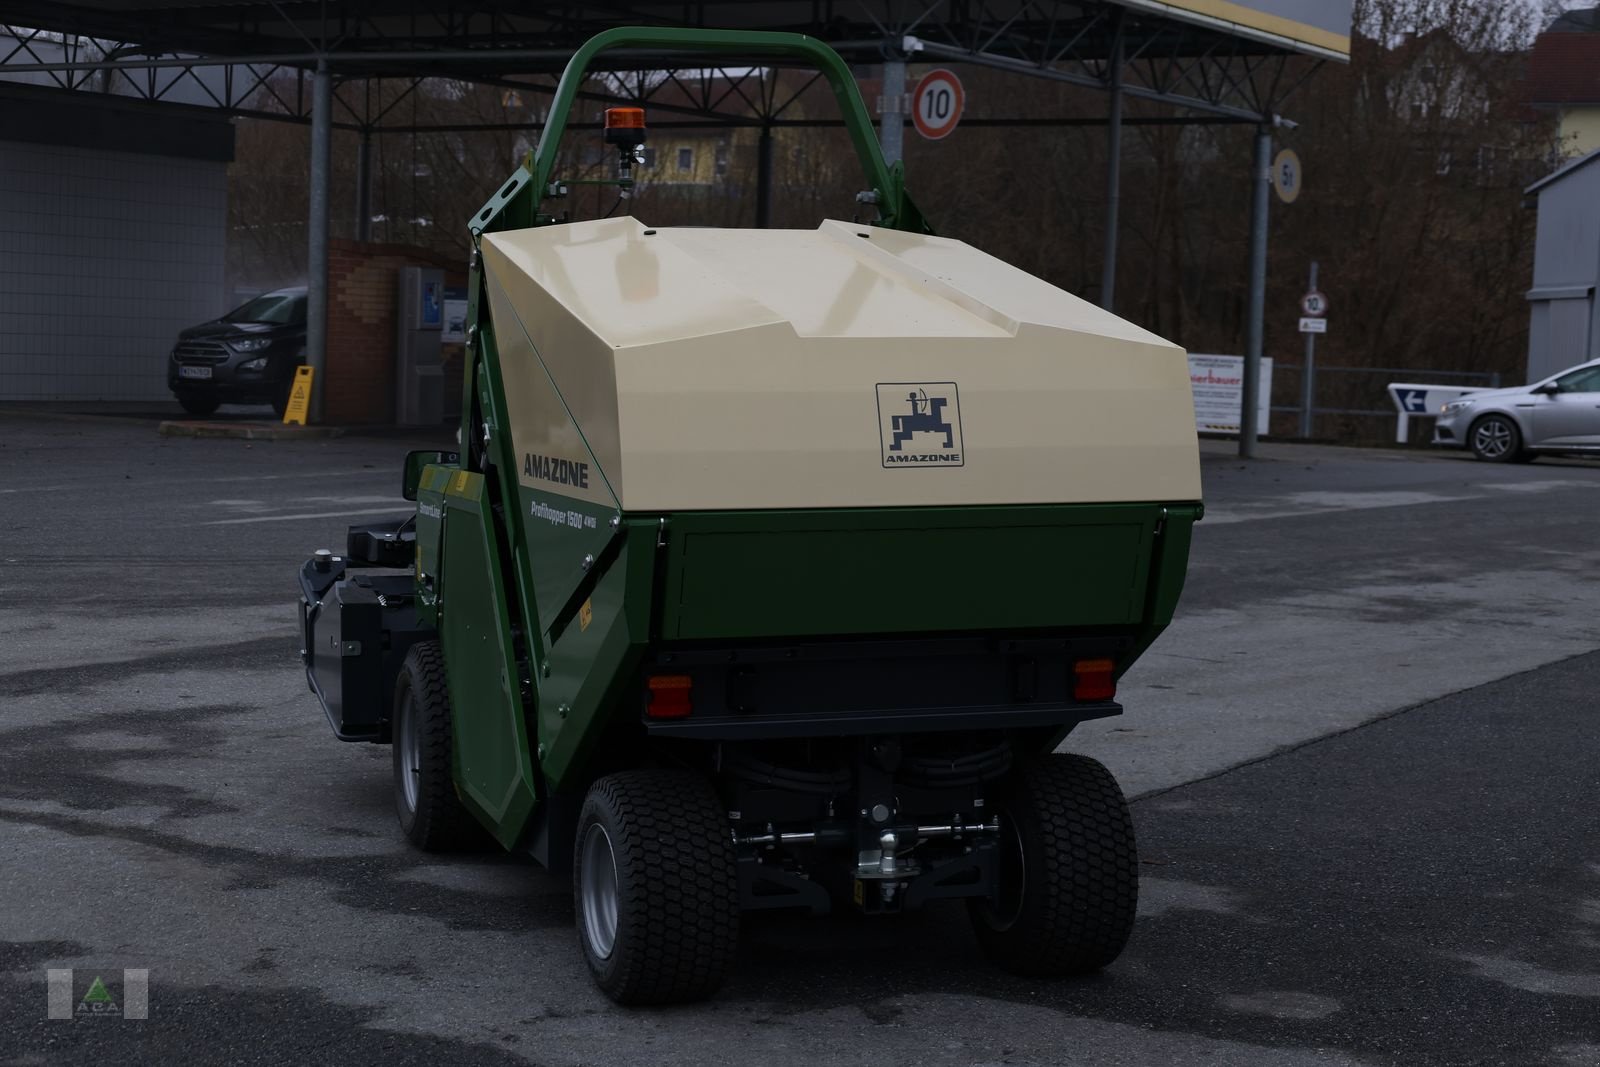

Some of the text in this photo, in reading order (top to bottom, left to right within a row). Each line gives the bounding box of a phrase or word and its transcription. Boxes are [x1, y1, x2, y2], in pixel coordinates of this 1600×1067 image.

[926, 89, 950, 119] 10
[523, 453, 589, 490] AMAZONE
[886, 454, 960, 463] AMAZONE
[530, 501, 566, 526] Profihopper
[567, 510, 583, 530] 1500
